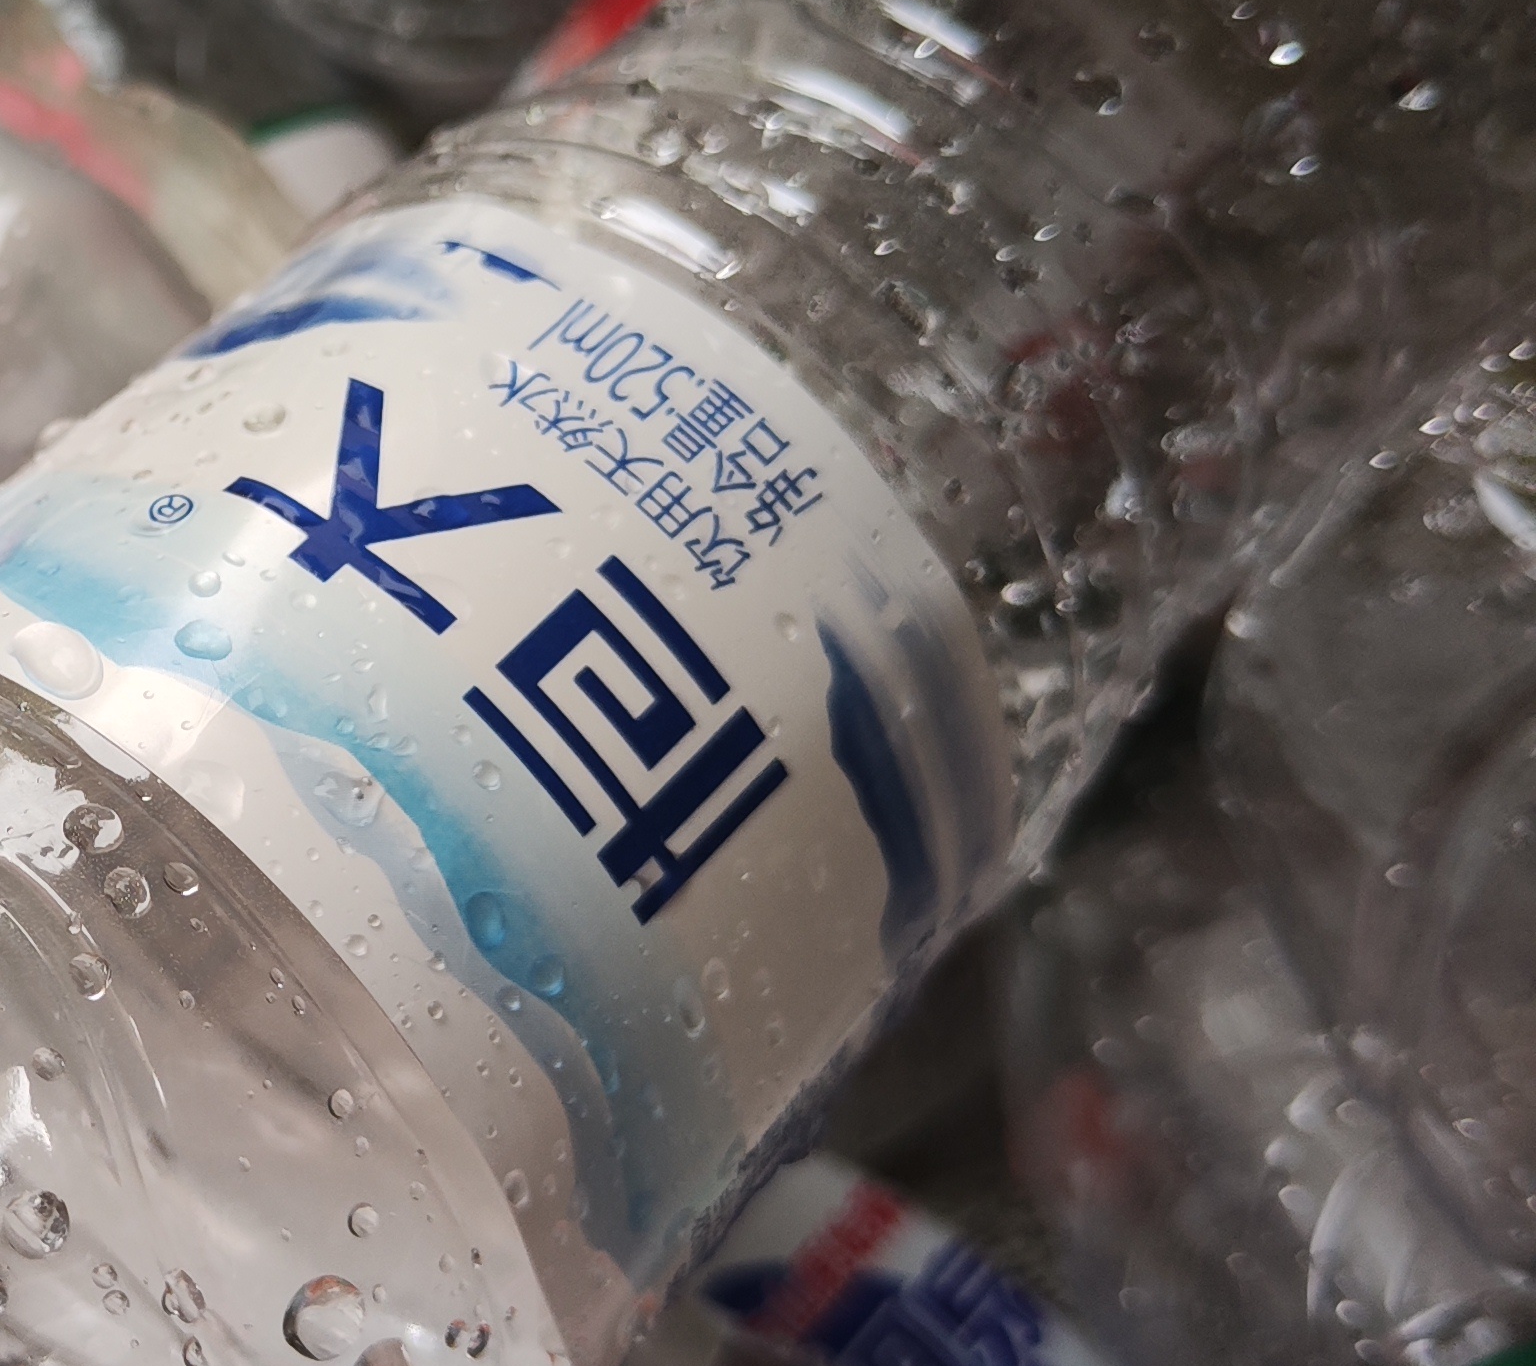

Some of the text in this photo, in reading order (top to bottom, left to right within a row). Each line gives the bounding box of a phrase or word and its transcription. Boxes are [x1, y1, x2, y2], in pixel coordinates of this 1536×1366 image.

[223, 376, 789, 927] 恒大
[488, 358, 754, 592] 饮用天然水
